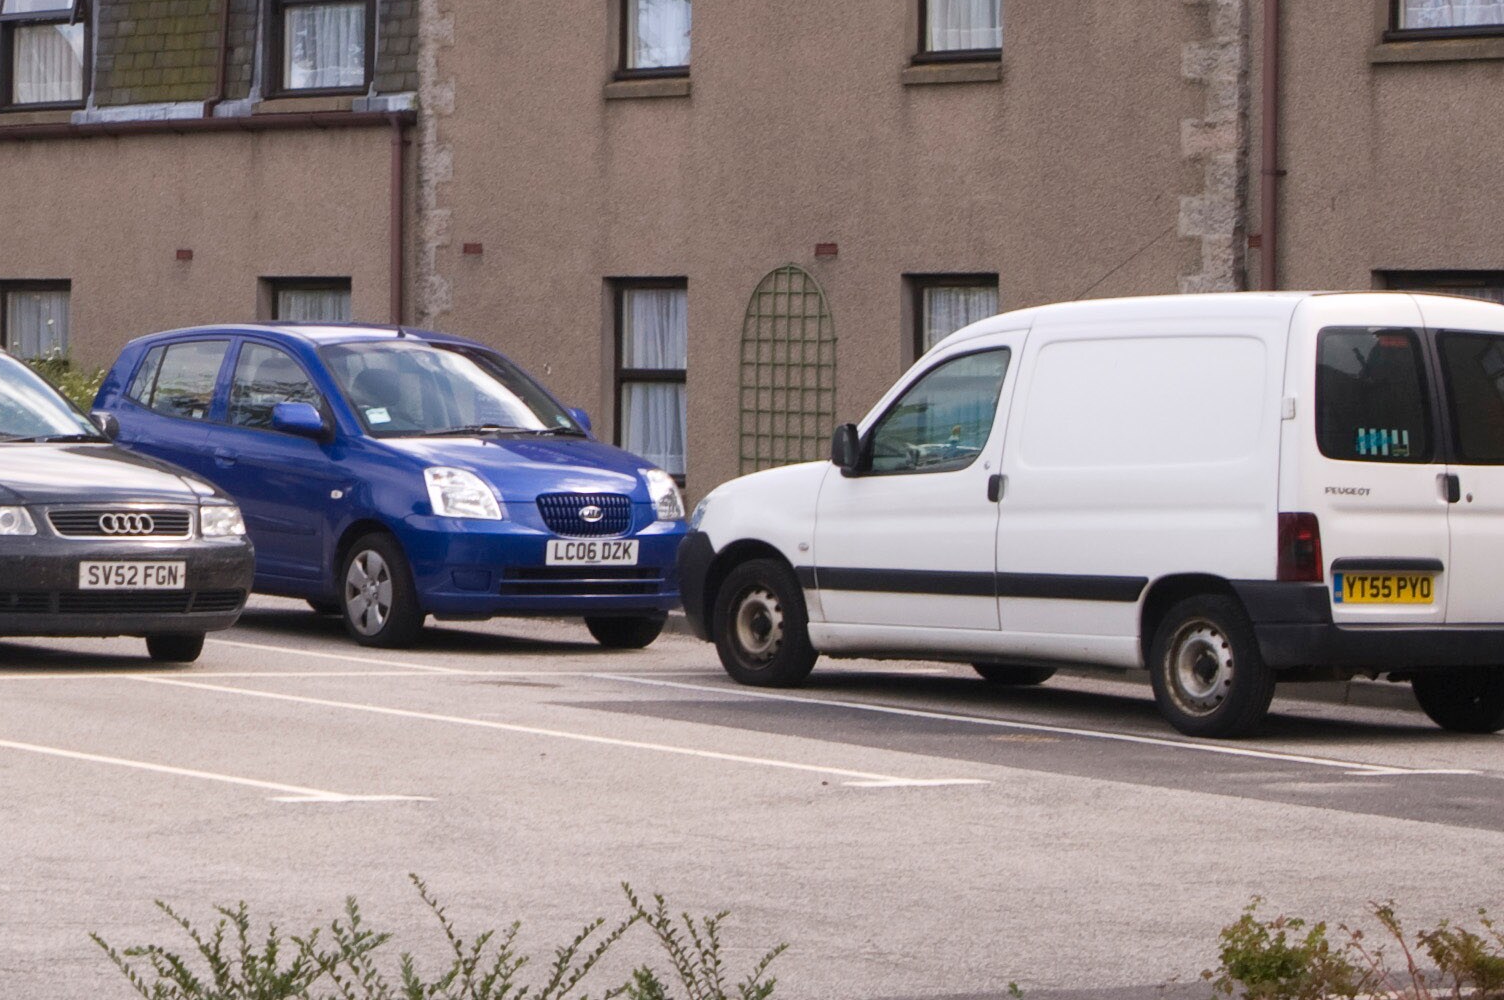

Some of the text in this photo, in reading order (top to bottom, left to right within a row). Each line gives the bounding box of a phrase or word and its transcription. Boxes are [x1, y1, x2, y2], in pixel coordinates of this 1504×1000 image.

[1324, 486, 1371, 496] PEUGEOT
[554, 542, 632, 561] LC06 DZK
[88, 565, 178, 586] SV52 FGN
[1346, 576, 1431, 598] YT55 PYO
